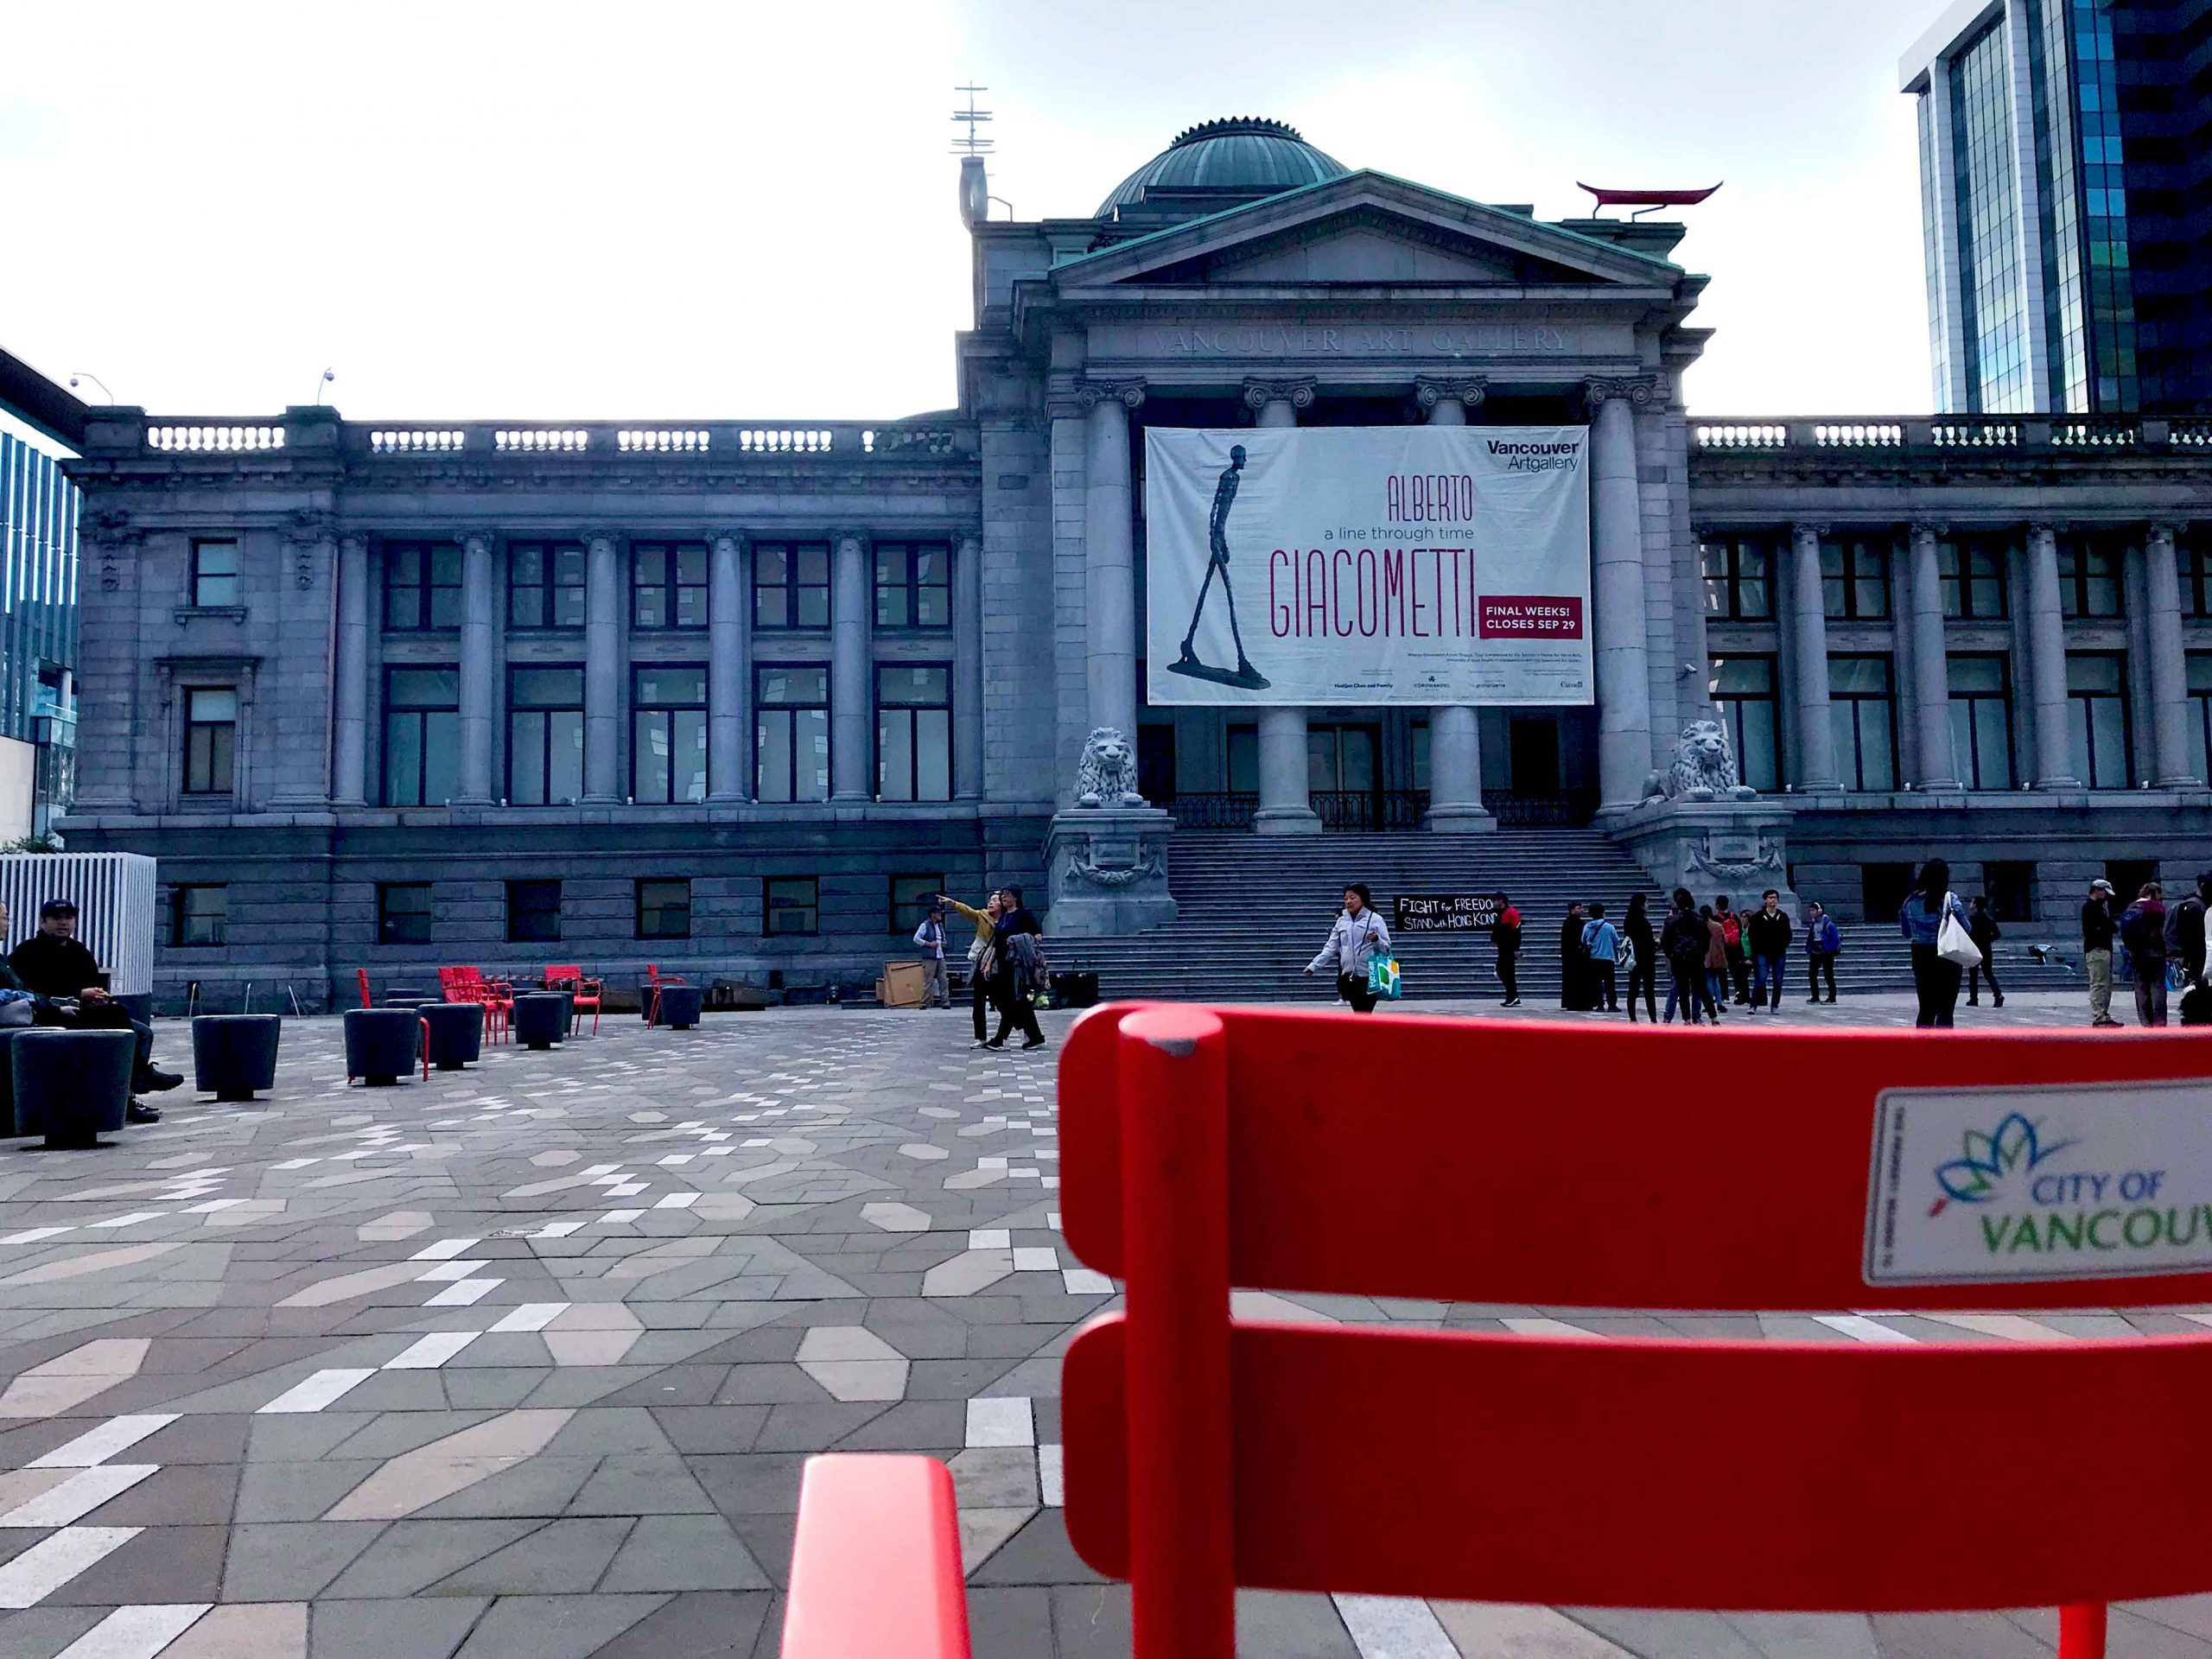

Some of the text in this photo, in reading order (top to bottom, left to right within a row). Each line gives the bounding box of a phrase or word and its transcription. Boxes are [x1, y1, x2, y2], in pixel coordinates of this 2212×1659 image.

[1154, 328, 1569, 352] VANCOUVER ART GALLERY
[1486, 440, 1580, 455] Vancouver
[1507, 455, 1579, 473] Artgallery
[1387, 474, 1474, 522] ALBERTO
[1324, 526, 1474, 542] a line through time
[1269, 548, 1475, 638] GIACOMETTI
[1485, 606, 1570, 616] FINAL WEEKS!
[1485, 620, 1576, 630] CLOSES SEP 29
[1400, 898, 1494, 913] FIGHT for FREEDO
[1404, 917, 1433, 930] STAND
[1447, 914, 1472, 929] HONG
[1368, 961, 1376, 988] Rexall
[2031, 1169, 2166, 1205] CITY OF
